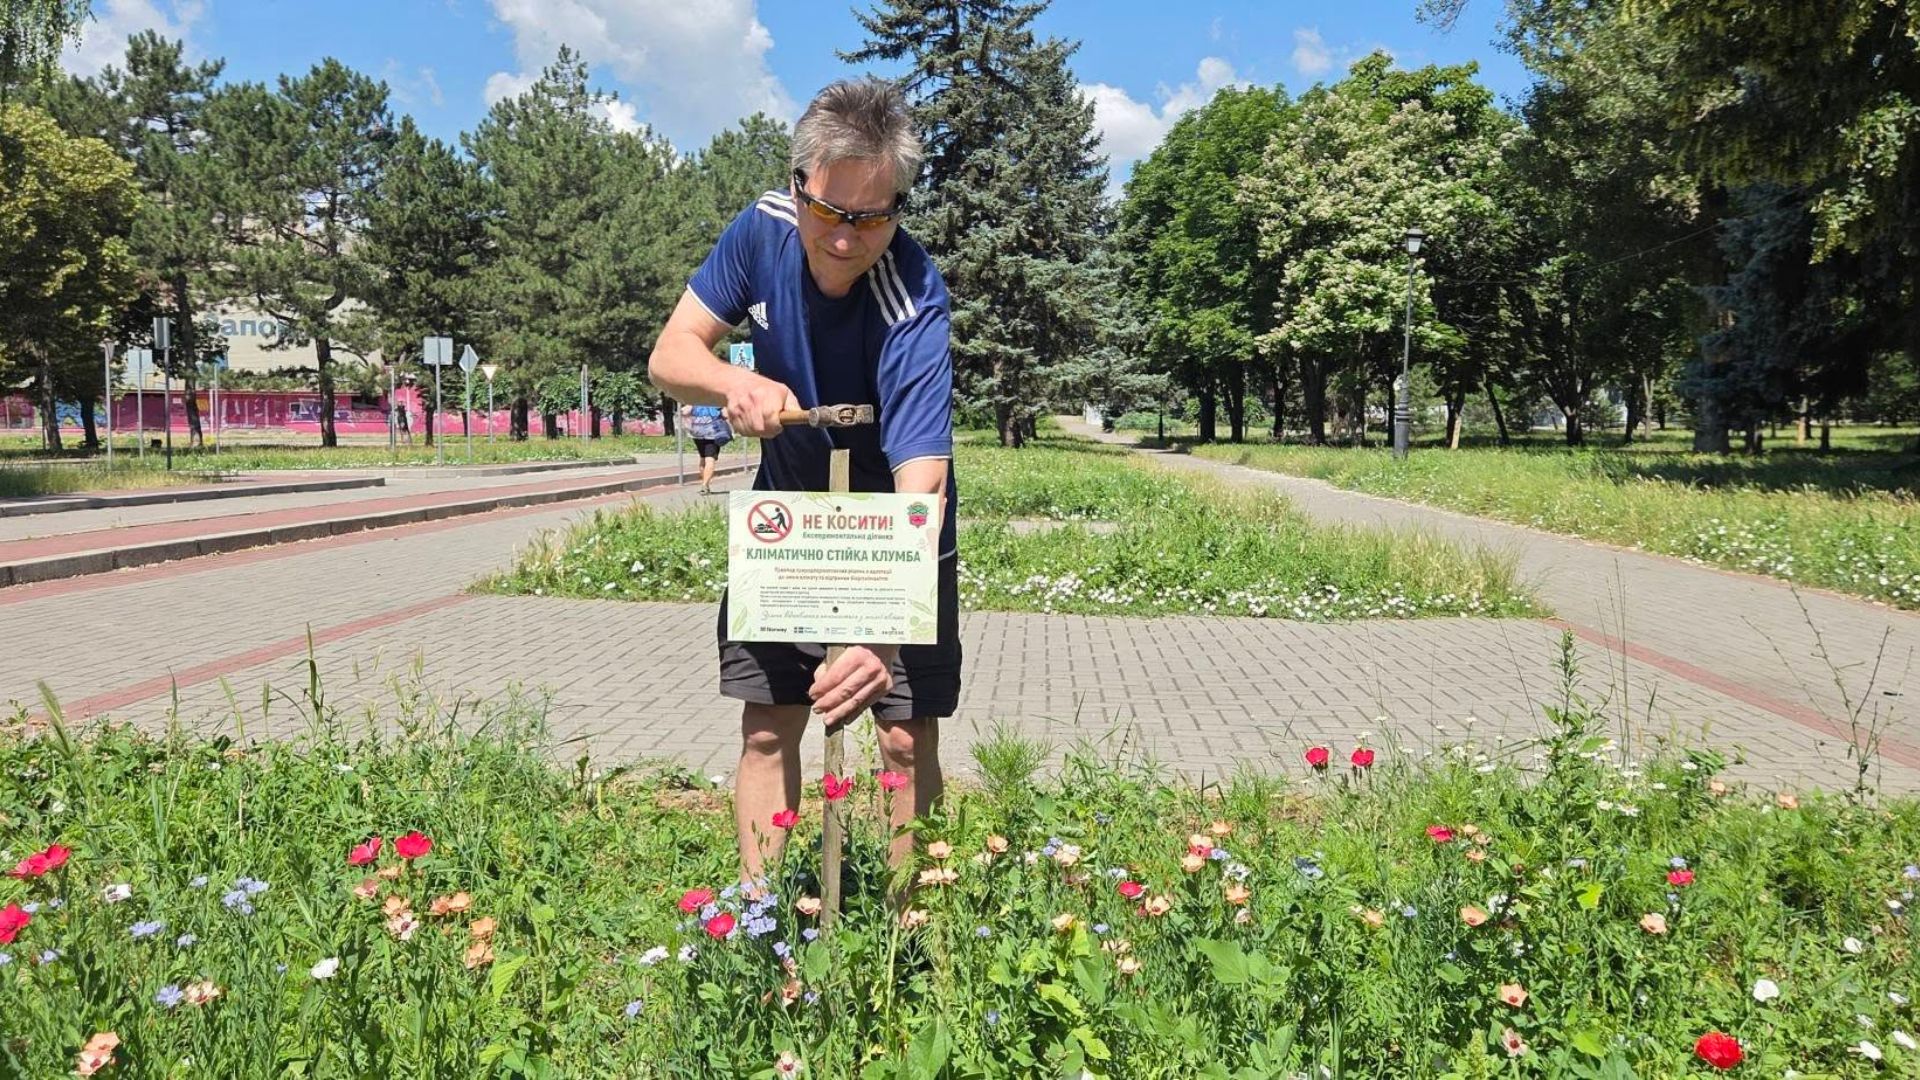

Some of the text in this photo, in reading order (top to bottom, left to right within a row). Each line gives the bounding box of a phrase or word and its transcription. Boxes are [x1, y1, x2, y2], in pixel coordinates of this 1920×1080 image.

[802, 514, 894, 531] НЕ КОСИТИ!
[746, 546, 921, 563] КЛІМАТИЧНО СТІЙКА КЛУМБА
